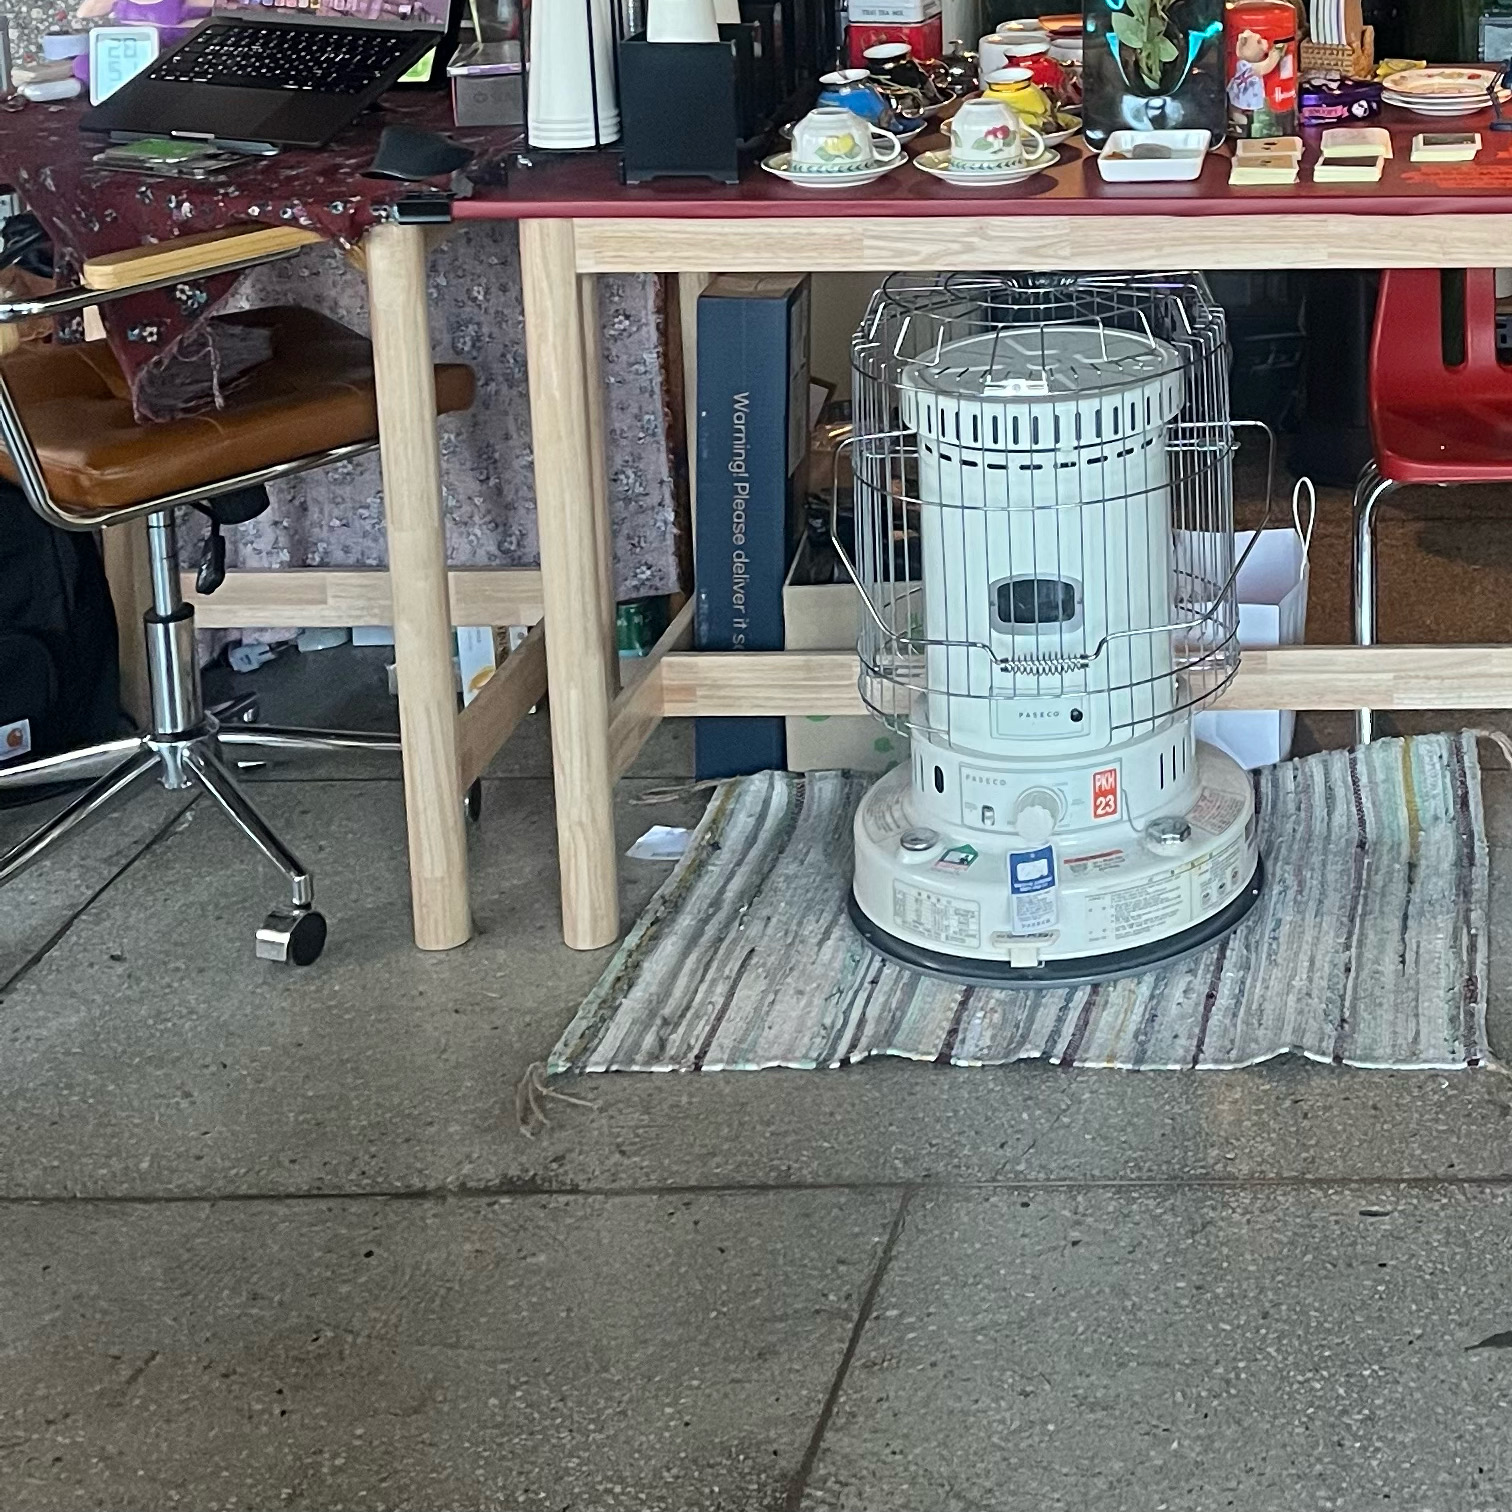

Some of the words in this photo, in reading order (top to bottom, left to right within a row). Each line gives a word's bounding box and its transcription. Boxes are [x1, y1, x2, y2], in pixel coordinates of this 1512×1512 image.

[728, 391, 750, 479] Warning!
[732, 483, 750, 546] Please
[732, 550, 750, 613] deliver
[732, 617, 750, 628] it
[1018, 711, 1060, 719] PASECO
[965, 774, 1007, 786] PASECO
[1095, 771, 1115, 793] PKH
[1095, 795, 1116, 815] 23
